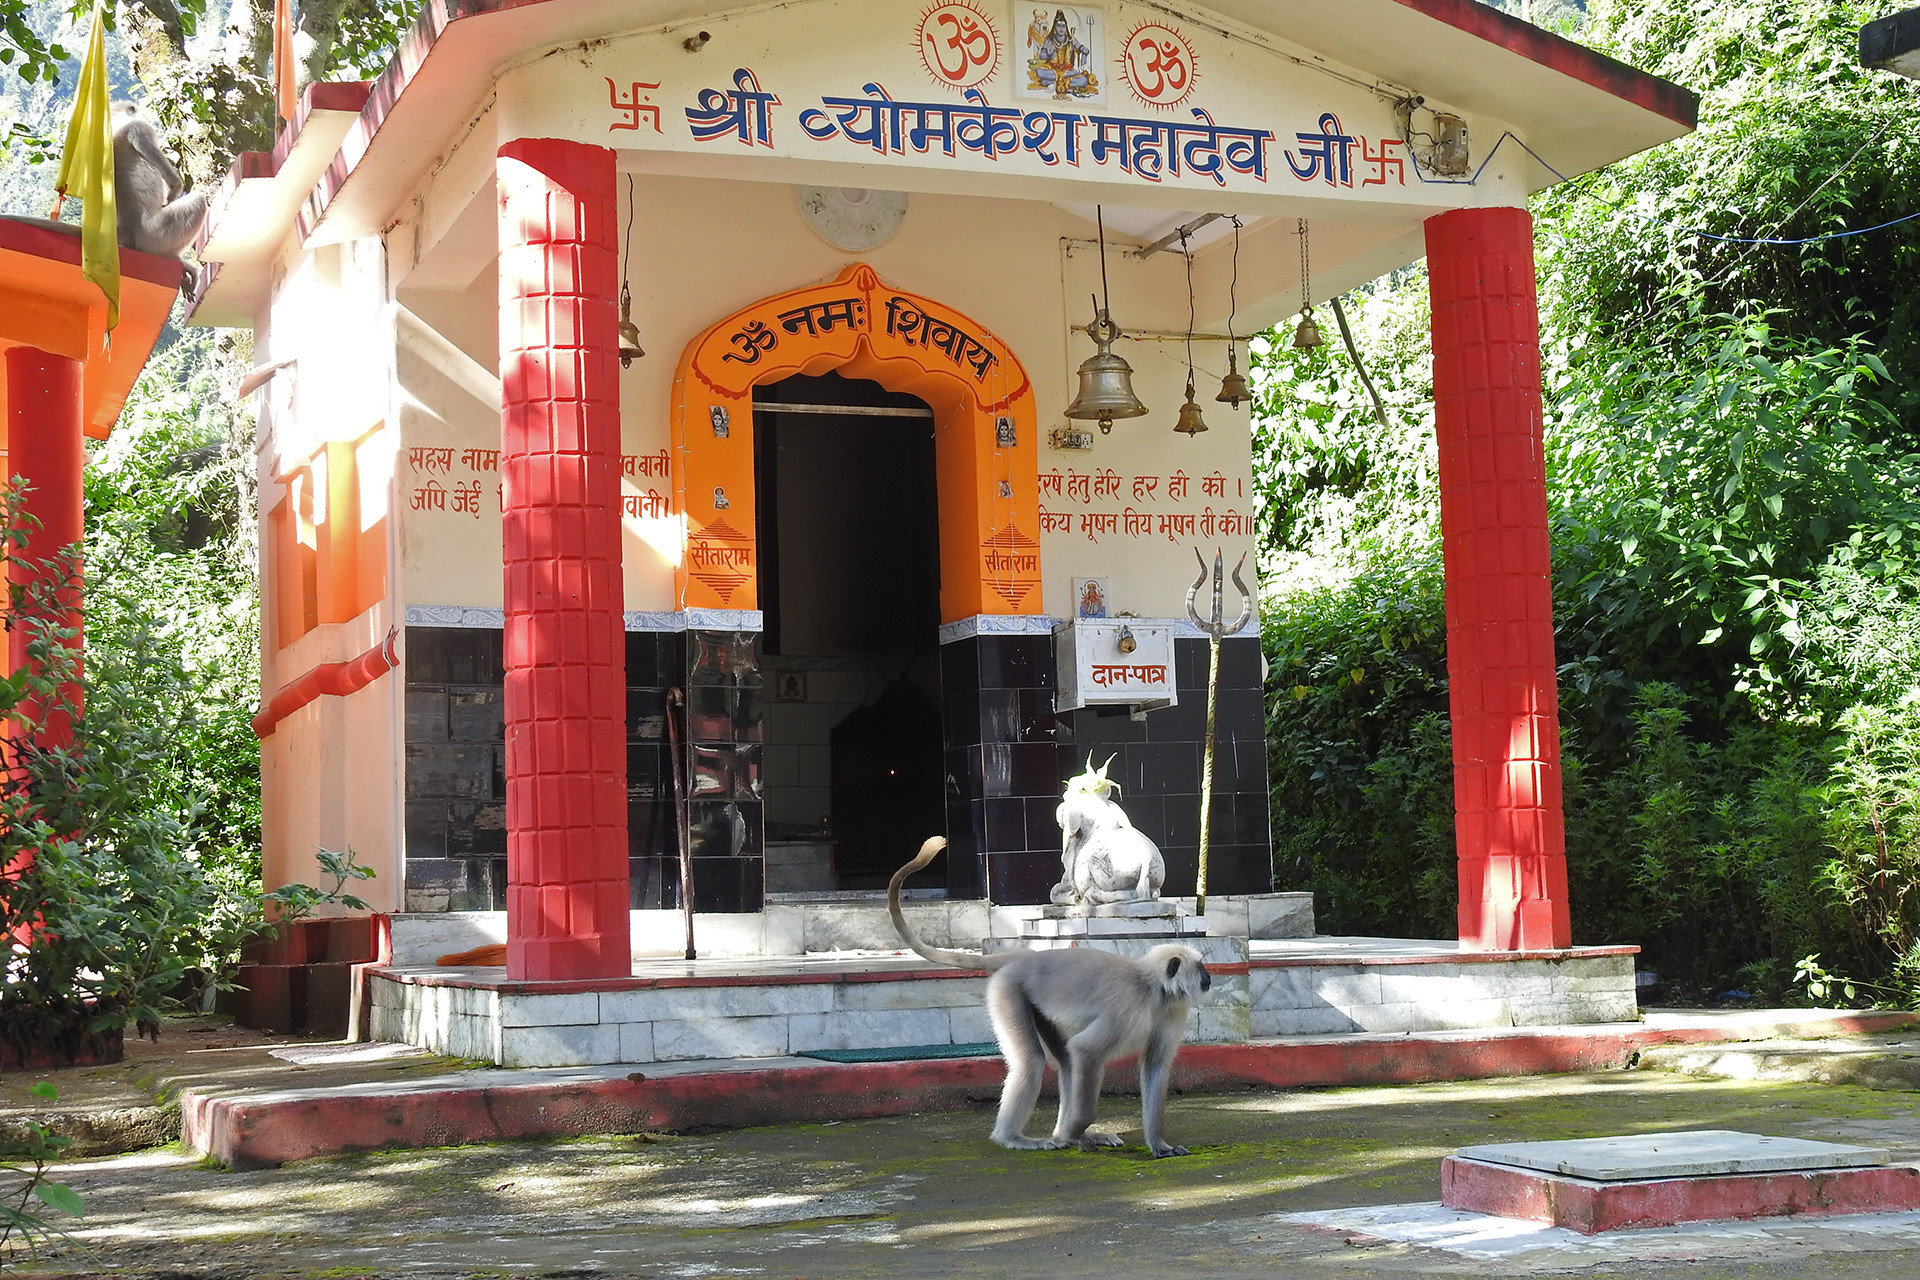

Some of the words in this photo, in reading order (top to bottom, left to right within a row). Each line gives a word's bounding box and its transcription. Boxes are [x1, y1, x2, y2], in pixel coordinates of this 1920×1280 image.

[684, 67, 781, 149] श्री
[799, 82, 1089, 168] व्योमकेश
[1090, 107, 1276, 187] महादेव
[1284, 111, 1353, 189] जी
[721, 319, 779, 366] ॐ
[777, 297, 866, 339] नमः
[884, 296, 999, 385] शिवाय
[409, 446, 456, 477] सहस
[461, 448, 502, 473] नाम
[638, 448, 671, 478] बानी
[409, 479, 449, 512] जपि
[1067, 467, 1091, 504] हेतु
[1093, 467, 1124, 501] हेरि
[1132, 475, 1160, 503] हर
[1168, 468, 1190, 503] ही
[1201, 470, 1228, 499] को
[1079, 512, 1120, 545] भूषन
[1121, 506, 1155, 540] तिय
[1156, 514, 1197, 547] भूषन
[1199, 506, 1218, 541] ती
[691, 540, 752, 570] सीताराम
[984, 549, 1037, 574] सीताराम
[1091, 664, 1167, 689] दान-पात्र
